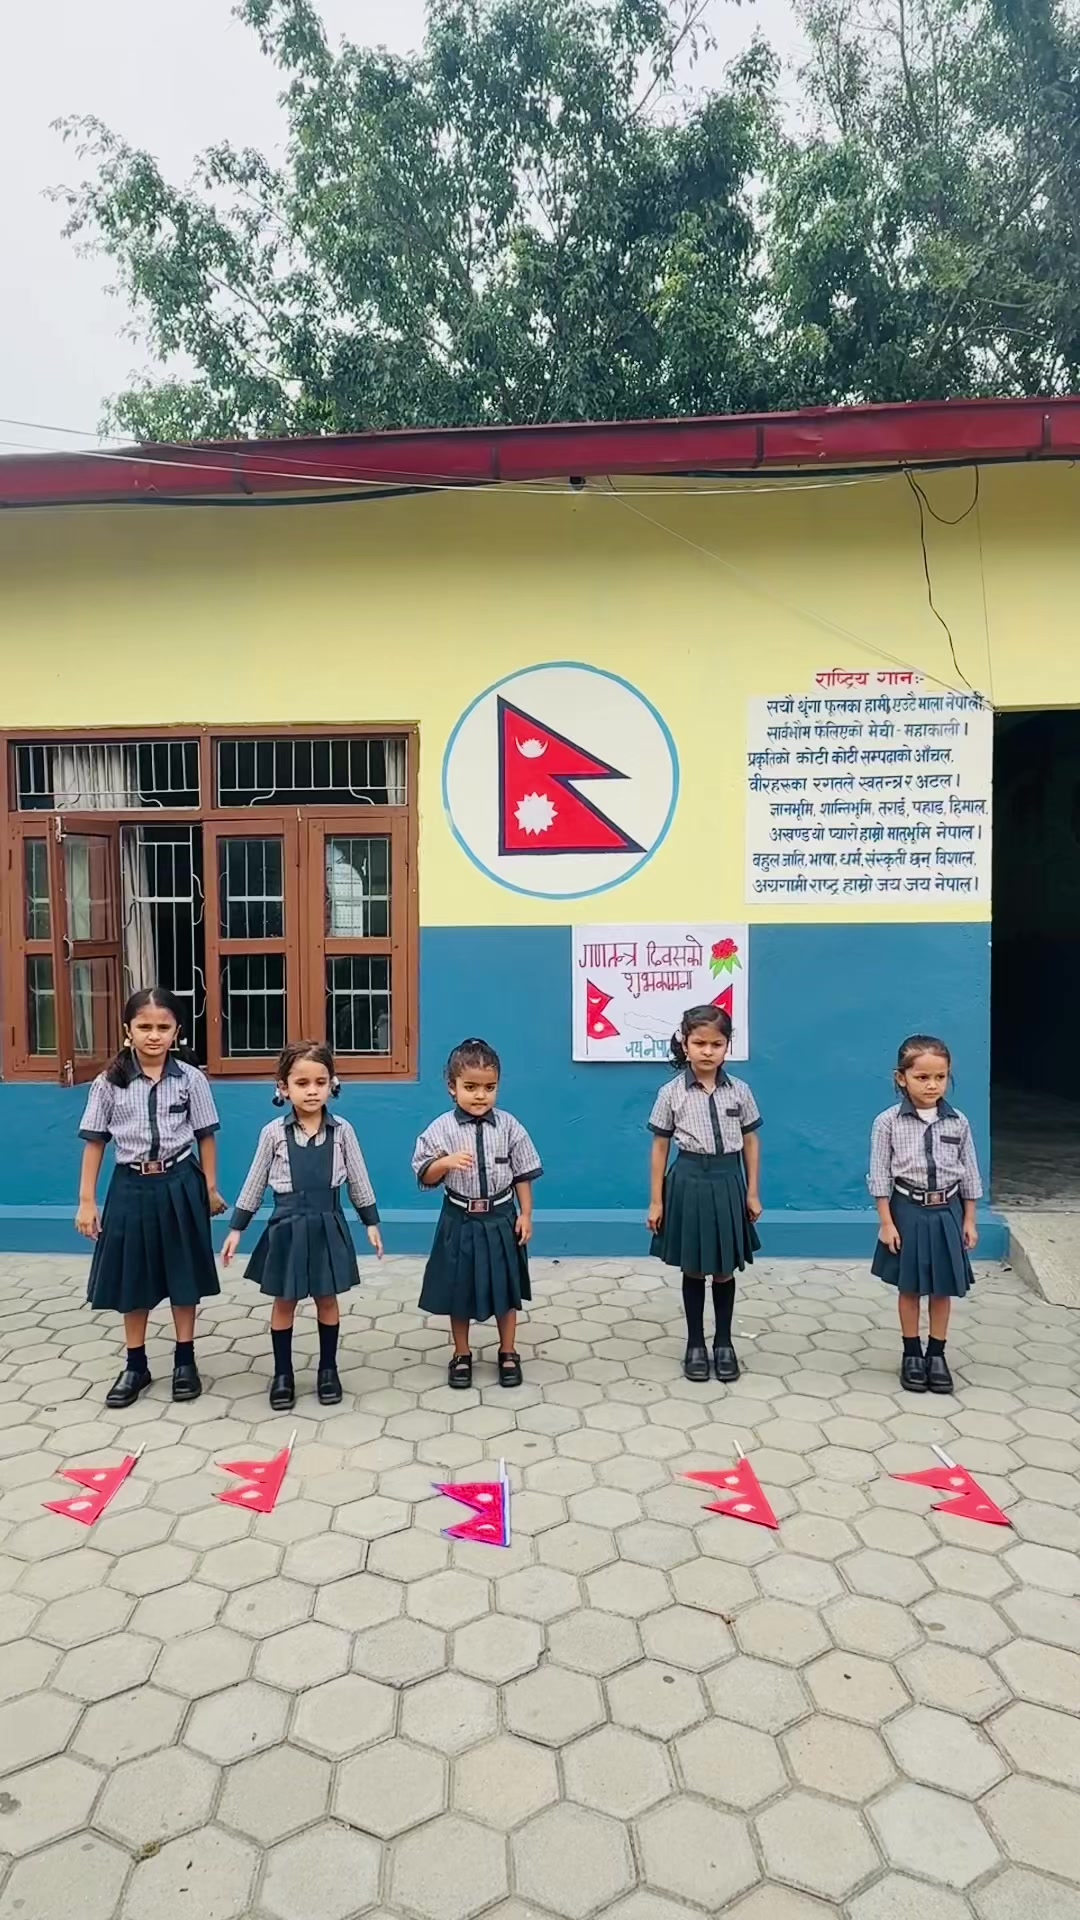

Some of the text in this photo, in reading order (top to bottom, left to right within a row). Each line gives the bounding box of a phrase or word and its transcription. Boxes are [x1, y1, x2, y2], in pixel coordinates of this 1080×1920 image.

[918, 697, 944, 713] माला
[796, 747, 829, 765] कोटी
[831, 746, 859, 764] कोटी
[860, 744, 913, 766] सम्पदाको
[813, 772, 855, 793] रगतले
[916, 775, 953, 789] अटल
[769, 827, 812, 843] अखण्ड
[828, 822, 858, 842] प्यारो
[860, 821, 884, 845] हाम्रो
[936, 821, 975, 843] नेपाल
[752, 874, 808, 893] अग्रगामी
[843, 873, 873, 896] हाम्रो
[875, 878, 901, 891] जय
[904, 878, 931, 892] जय
[935, 872, 972, 893] नेपाल
